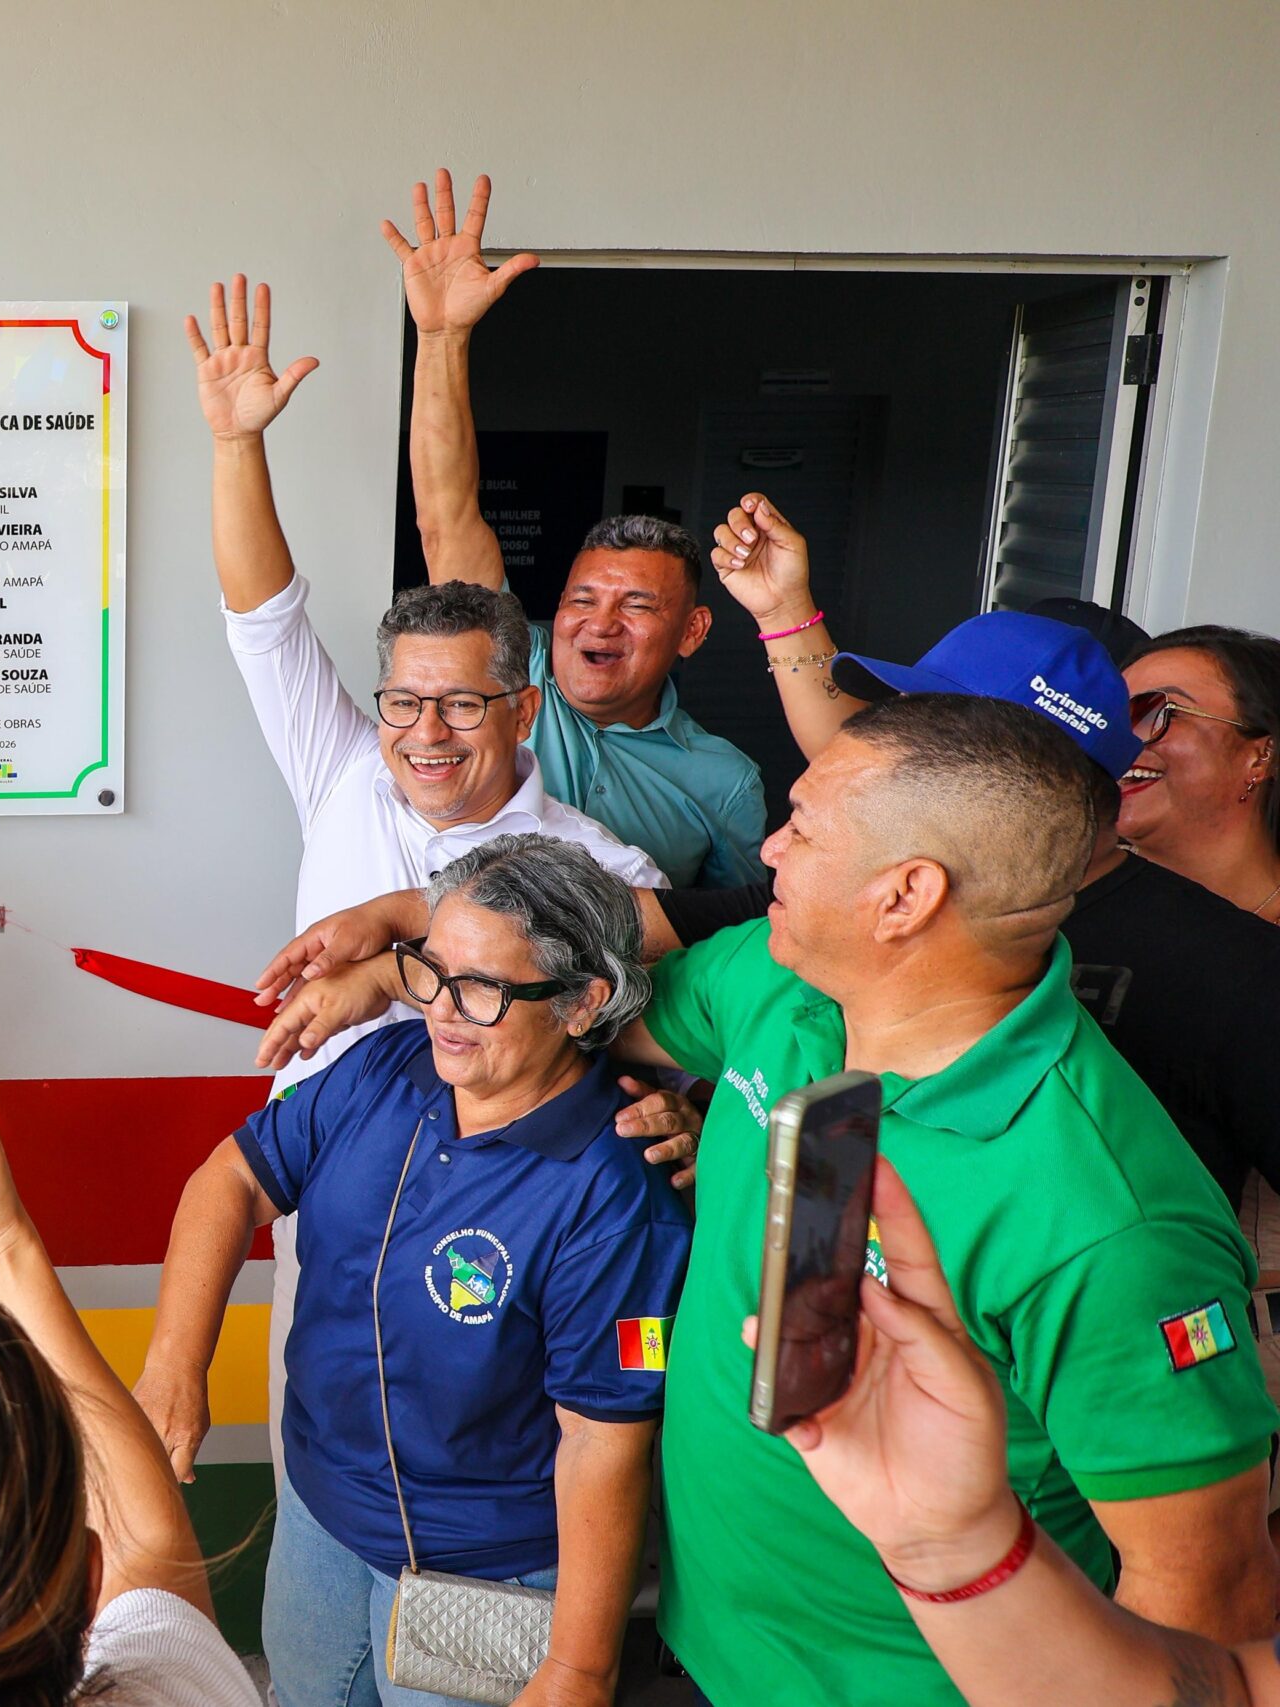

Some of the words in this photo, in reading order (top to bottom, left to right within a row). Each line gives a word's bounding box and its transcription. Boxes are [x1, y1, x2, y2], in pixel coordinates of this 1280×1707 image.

[23, 415, 42, 430] DE
[46, 412, 94, 430] SAÚDE
[486, 480, 518, 490] BUCAL
[0, 487, 38, 499] SILVA
[500, 510, 541, 520] MULHER
[499, 526, 542, 537] CRIANÇA
[11, 538, 52, 551] AMAPÁ
[503, 555, 535, 565] OMEM
[3, 575, 44, 587] AMAPÁ
[3, 646, 41, 659] SAÚDE
[1, 669, 48, 681] SOUZA
[14, 682, 51, 694] SAÚDE
[1030, 675, 1108, 730] Dorinaldo
[1034, 695, 1090, 734] Malafaia
[4, 718, 42, 729] OBRAS
[433, 1228, 474, 1256] CONSELHO
[475, 1228, 510, 1262] MUNICIPAL
[506, 1263, 513, 1277] DE
[424, 1265, 449, 1313] MUNICÍPIO
[449, 1310, 463, 1322] DE
[463, 1310, 494, 1325] AMAPÁ
